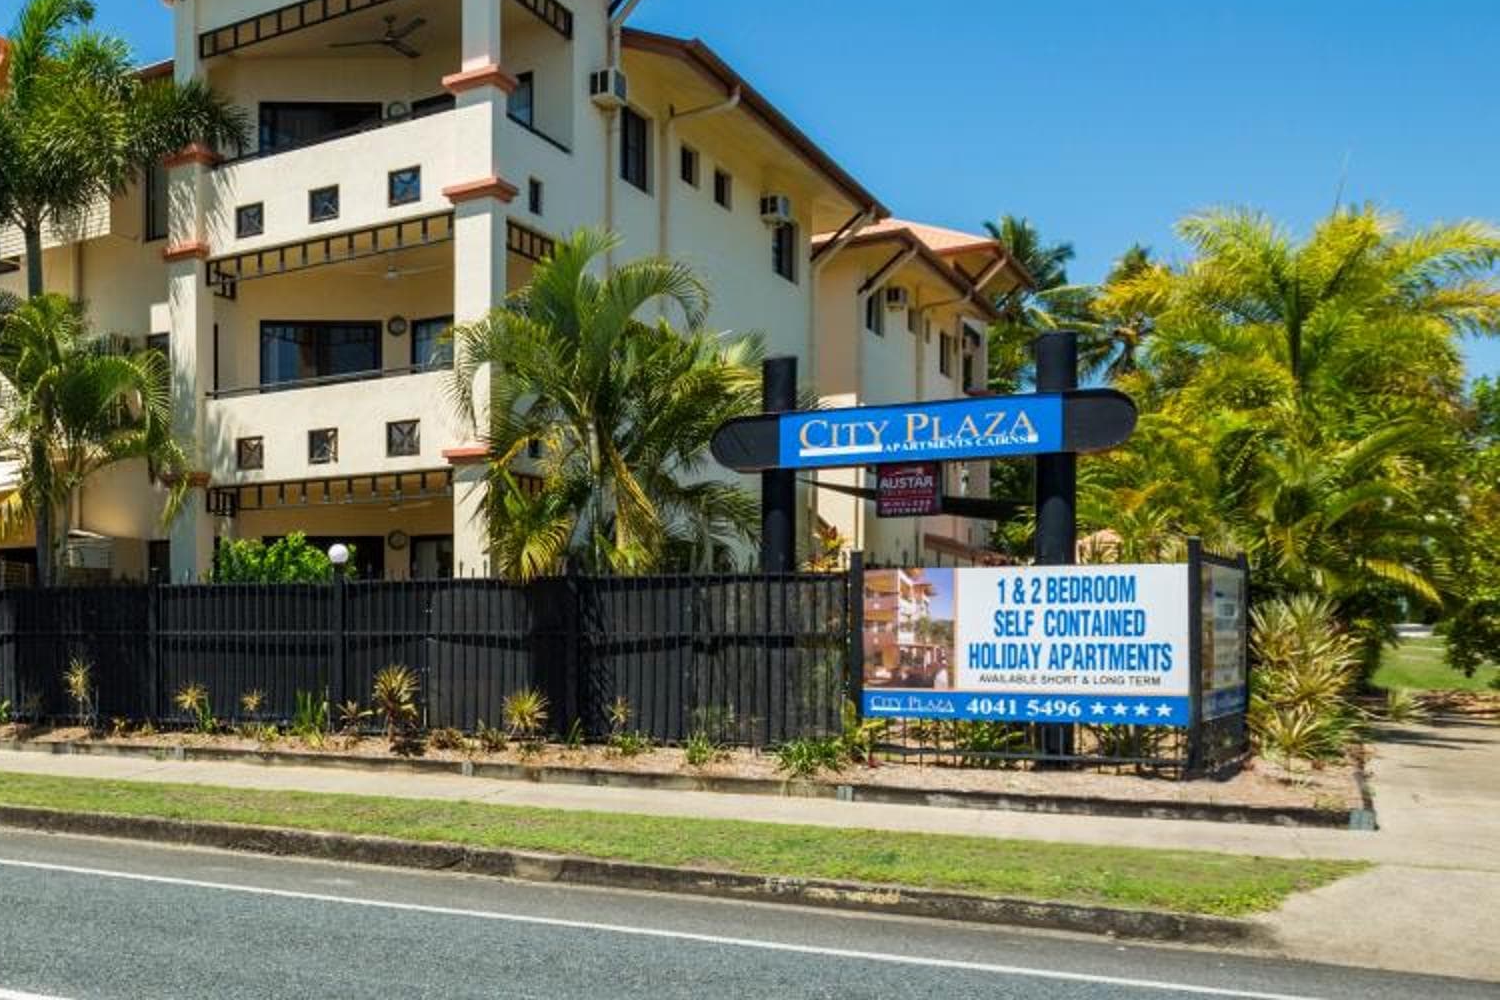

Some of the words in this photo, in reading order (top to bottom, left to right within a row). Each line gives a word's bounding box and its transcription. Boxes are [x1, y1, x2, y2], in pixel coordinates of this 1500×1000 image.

[884, 436, 973, 453] APARTMENTS
[975, 433, 1027, 447] CAIRNS
[880, 475, 933, 489] AUSTAR
[997, 578, 1005, 604] 1
[1012, 577, 1026, 604] &
[1031, 577, 1042, 603] 2
[1046, 575, 1136, 602] BEDROOM
[994, 610, 1034, 637] SELF
[1043, 609, 1146, 637] CONTAINED
[969, 642, 1042, 670] HOLIDAY
[1047, 643, 1173, 671] APARTMENTS
[979, 674, 1038, 685] AVAILABLE
[1040, 675, 1077, 685] SHORT
[1082, 676, 1090, 685] &
[1093, 676, 1126, 686] LONG
[1129, 676, 1161, 686] TERM
[966, 698, 1017, 715] 4041
[1027, 699, 1082, 717] 5496
